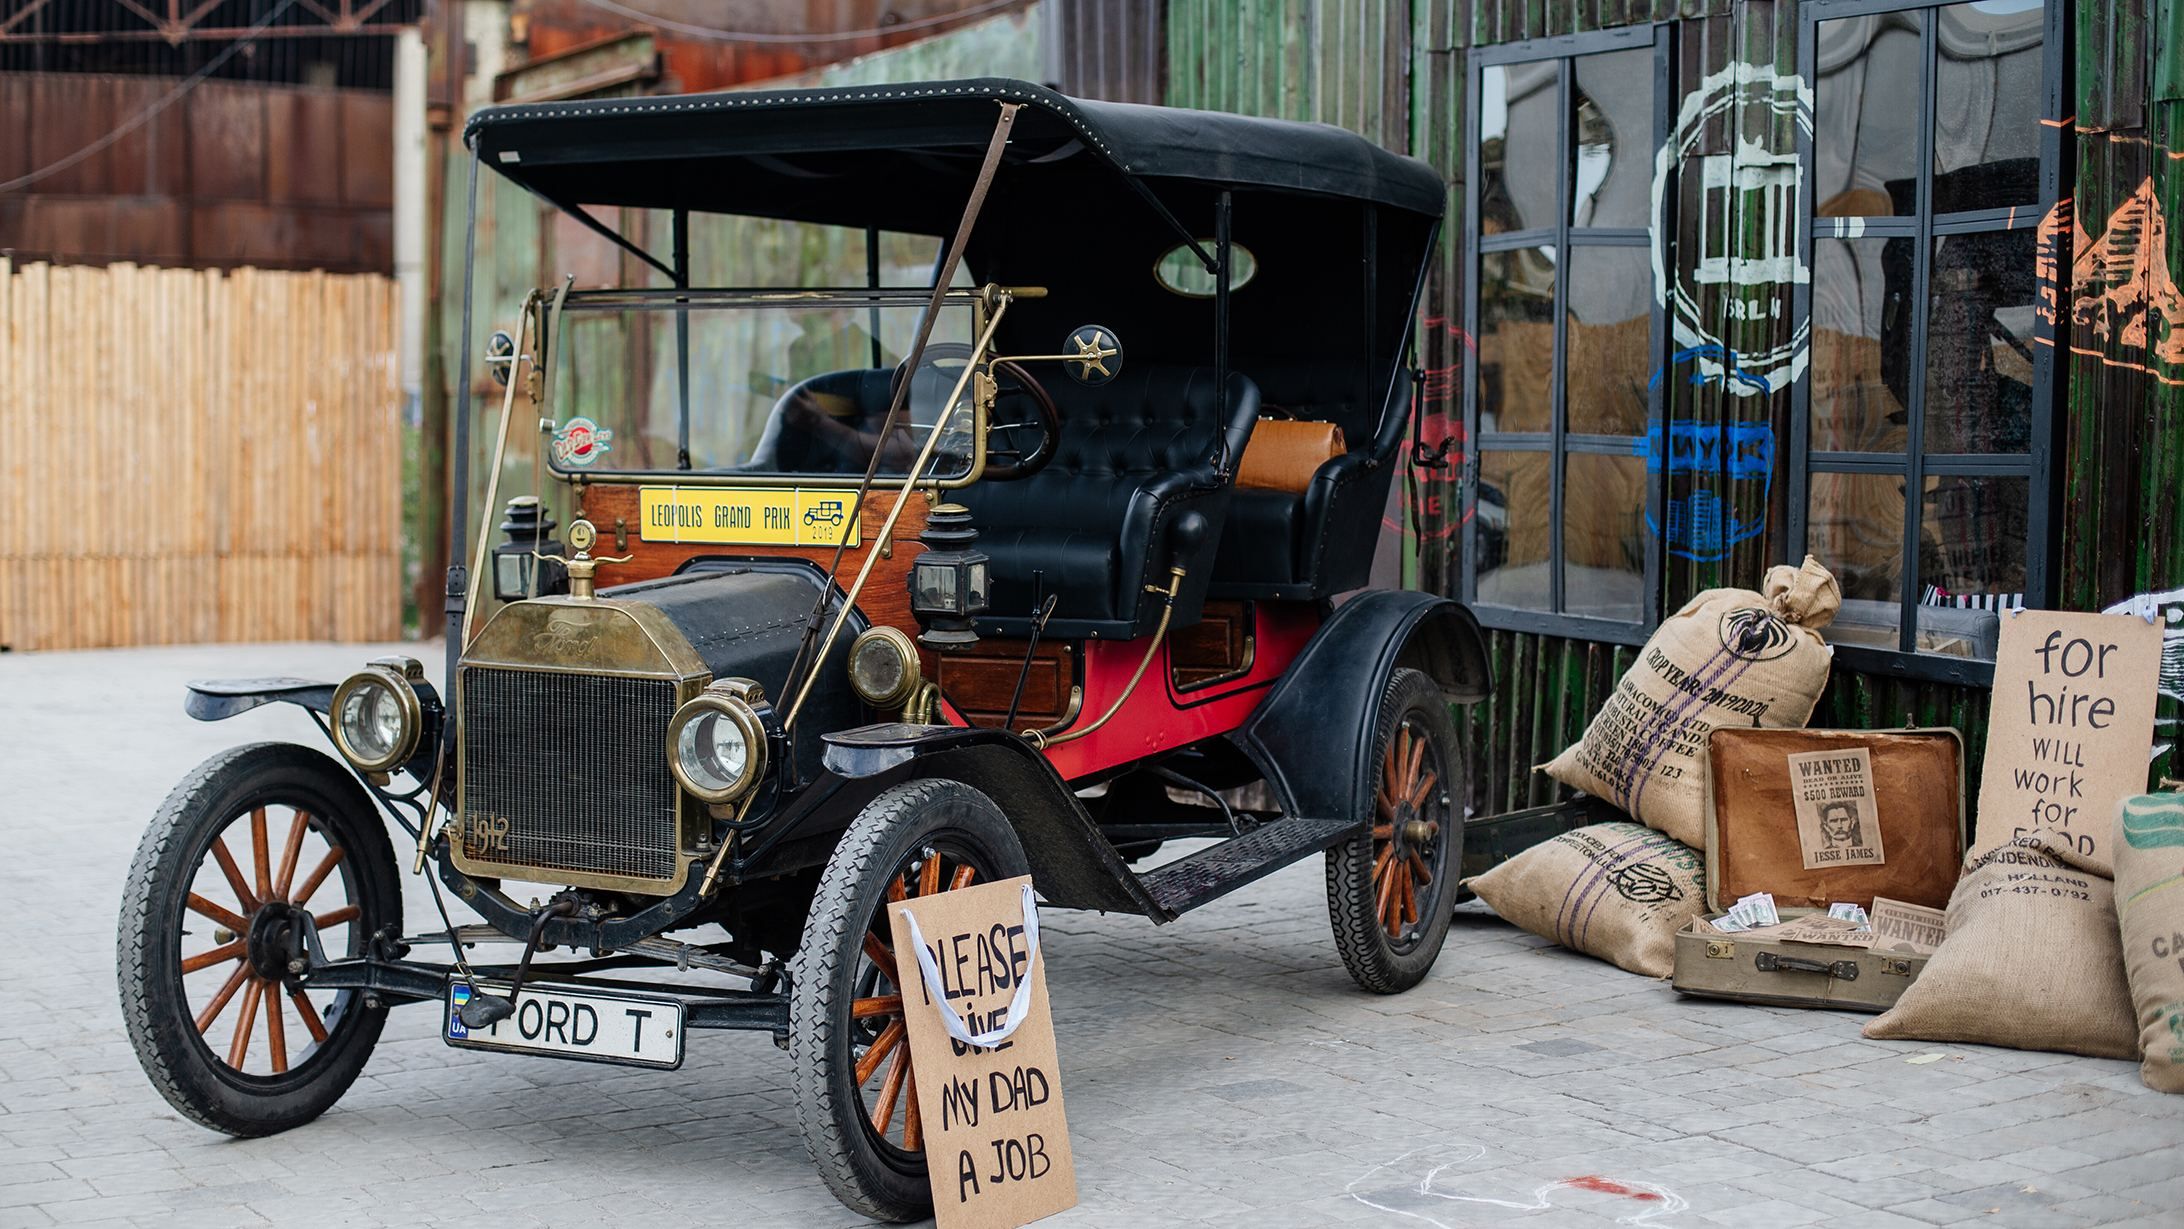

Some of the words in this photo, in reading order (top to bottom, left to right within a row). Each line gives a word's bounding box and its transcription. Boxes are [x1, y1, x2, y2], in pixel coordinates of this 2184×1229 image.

[651, 504, 702, 528] LEOPOLIS
[714, 505, 751, 529] GRAND
[764, 506, 790, 530] PRIX
[812, 526, 833, 540] 2019
[533, 620, 598, 657] Ford
[1645, 647, 1667, 673] CROP
[2034, 630, 2118, 678] for
[2028, 680, 2115, 729] hire
[1799, 758, 1861, 777] WANTED
[2033, 738, 2085, 768] WILL
[1804, 788, 1826, 801] $500
[1830, 786, 1865, 799] REWARD
[2032, 798, 2078, 827] for
[472, 810, 509, 855] 1912
[2014, 827, 2096, 857] FD
[1814, 851, 1841, 863] JESSE
[1846, 848, 1874, 861] JAMES
[2007, 873, 2089, 889] HOLLAND
[1802, 932, 1874, 943] WANTED
[917, 923, 1027, 1005] PLEASE
[452, 1021, 467, 1034] UA
[625, 1008, 652, 1053] T
[989, 1065, 1050, 1114] DAD
[959, 1149, 981, 1203] A
[990, 1133, 1051, 1184] JOB
